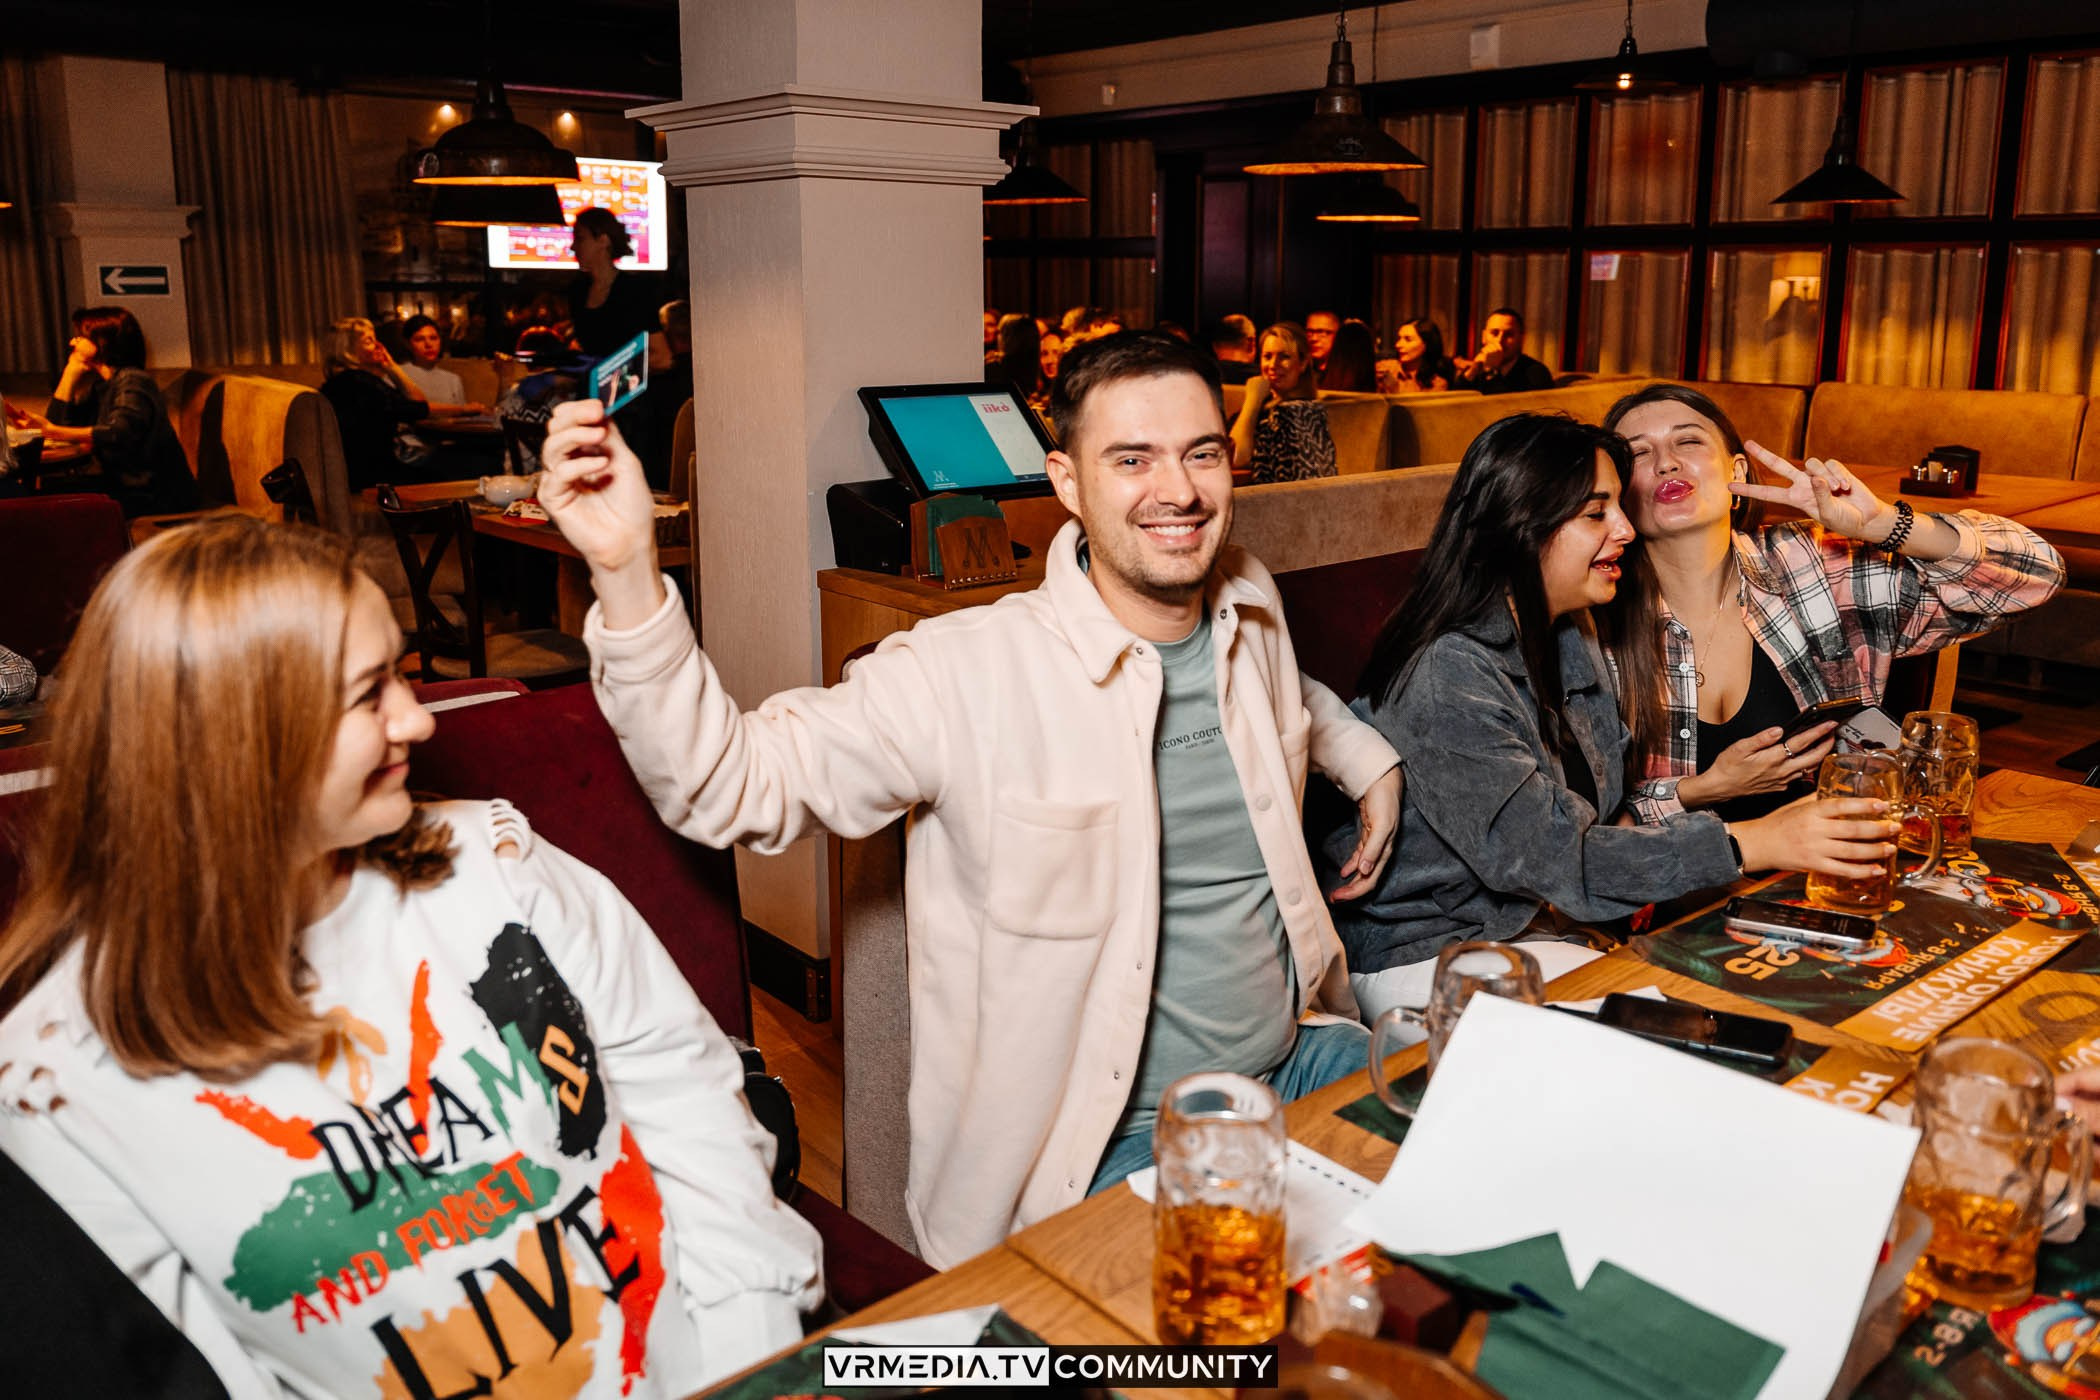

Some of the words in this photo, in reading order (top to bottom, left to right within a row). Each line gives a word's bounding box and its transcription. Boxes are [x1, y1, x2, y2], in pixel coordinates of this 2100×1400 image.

[1724, 944, 1800, 981] 25
[1871, 935, 2029, 1021] КАНИКУЛЫ
[1891, 934, 2079, 1042] НОВОГОДНИЕ
[309, 1022, 590, 1213] DREAMS
[290, 1249, 390, 1333] AND
[396, 1150, 535, 1273] FORGET
[371, 1185, 641, 1400] LIVE
